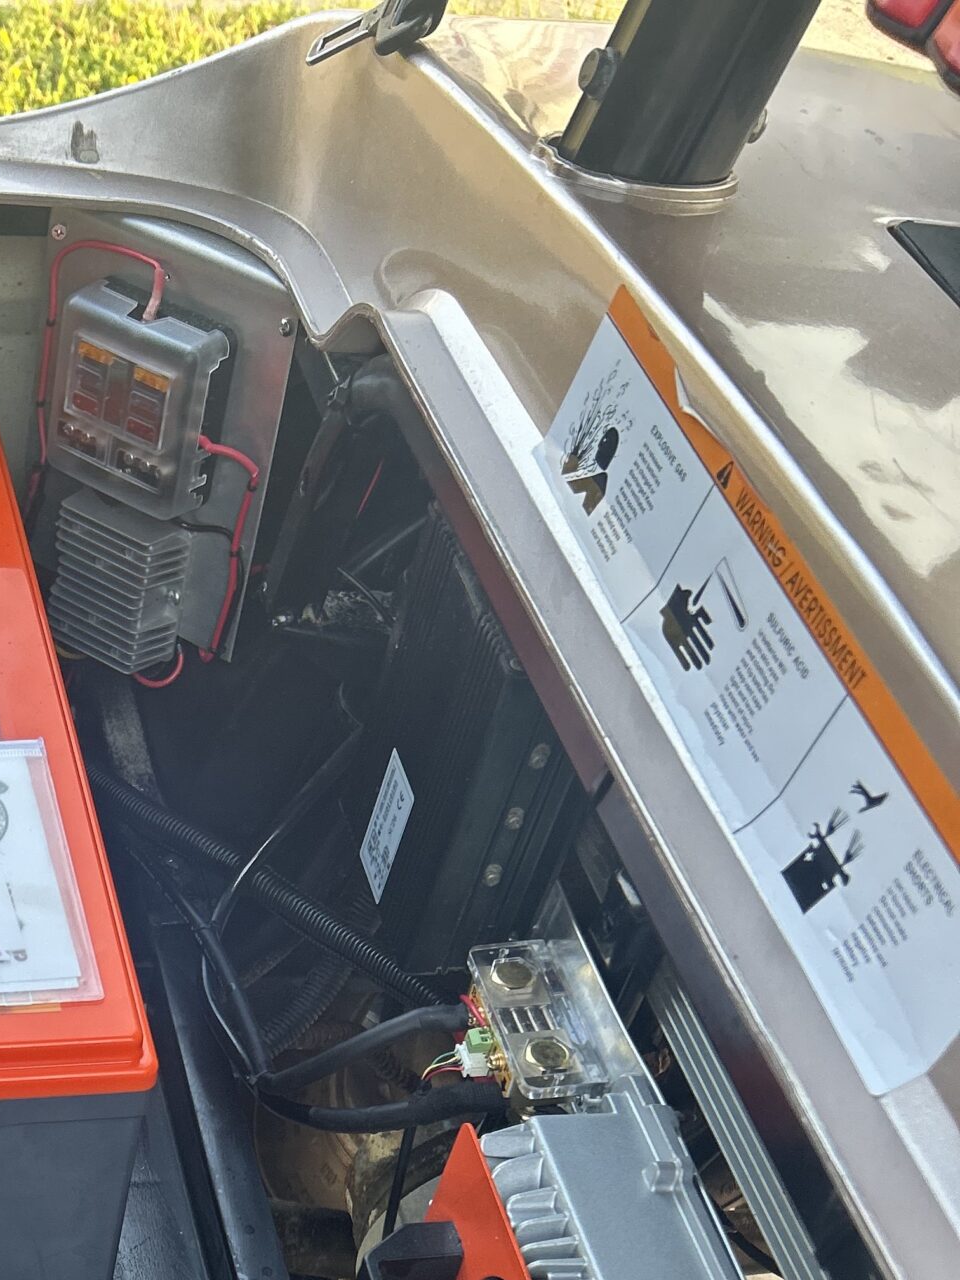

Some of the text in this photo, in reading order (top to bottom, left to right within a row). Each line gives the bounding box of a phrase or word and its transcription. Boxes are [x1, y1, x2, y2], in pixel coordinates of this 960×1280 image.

[650, 425, 687, 482] EXPLOSIVE GAS
[735, 487, 786, 568] WARNING
[766, 613, 808, 680] SULFURIC ACID
